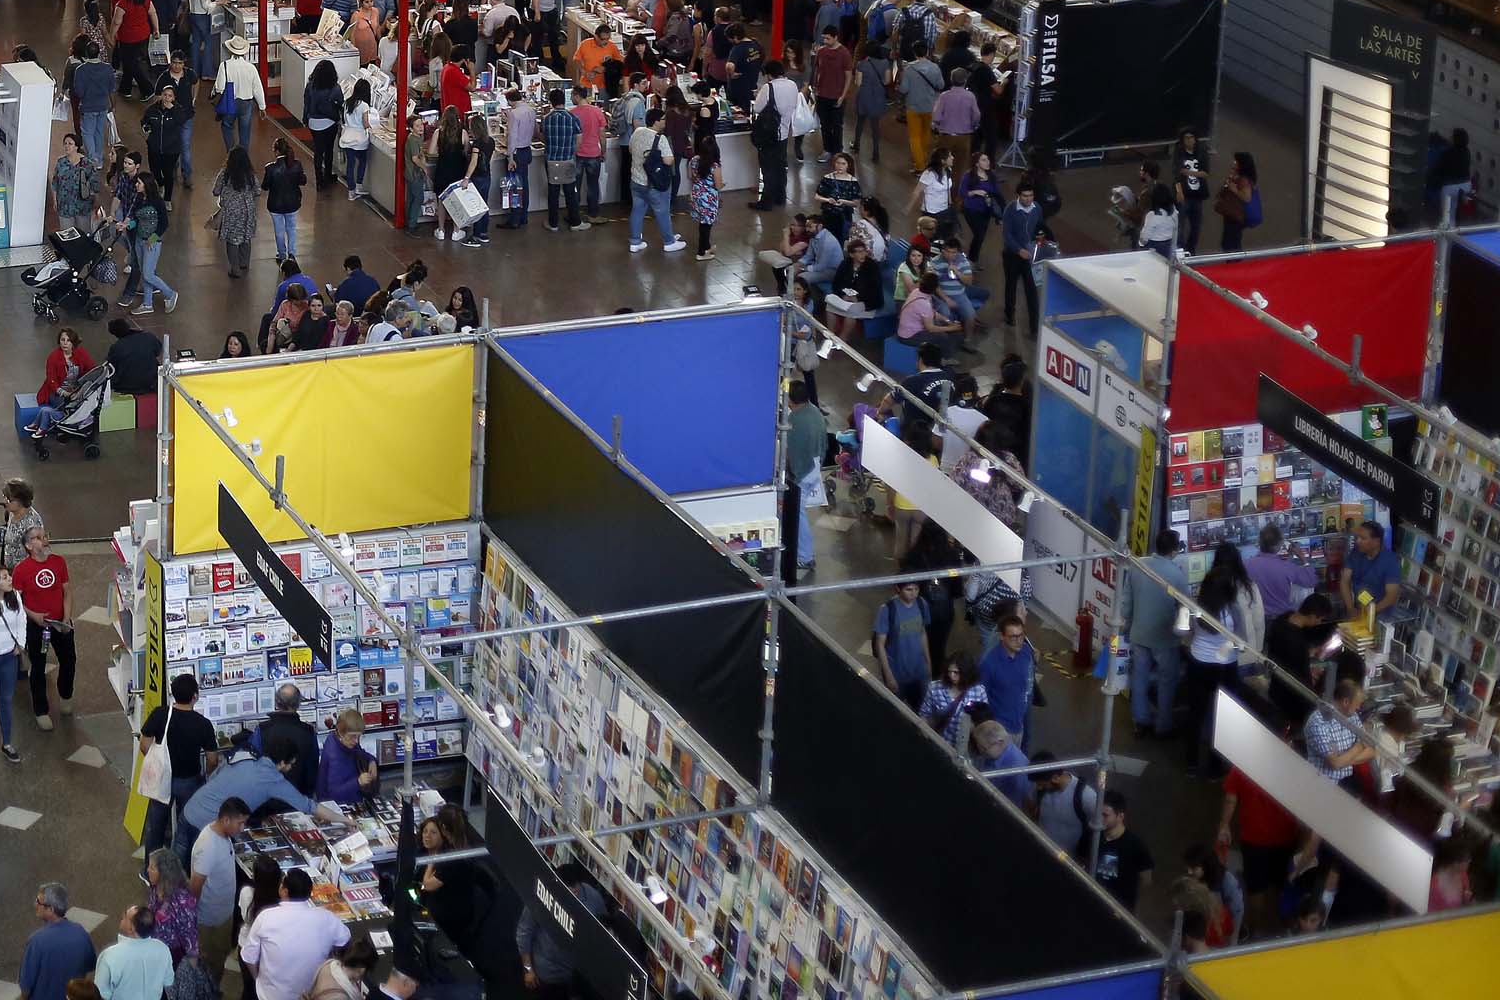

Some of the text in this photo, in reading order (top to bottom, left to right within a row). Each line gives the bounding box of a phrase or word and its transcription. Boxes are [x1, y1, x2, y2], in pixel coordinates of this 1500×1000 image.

[1041, 38, 1057, 86] FILSA
[1360, 36, 1421, 65] LAS ARTES
[1372, 26, 1422, 49] SALA DE
[1047, 346, 1091, 396] ADN
[1294, 416, 1395, 491] LIBRERÍA HOJAS DE PARRA
[149, 616, 159, 692] FILSA
[536, 878, 575, 938] EDAF CHILE
